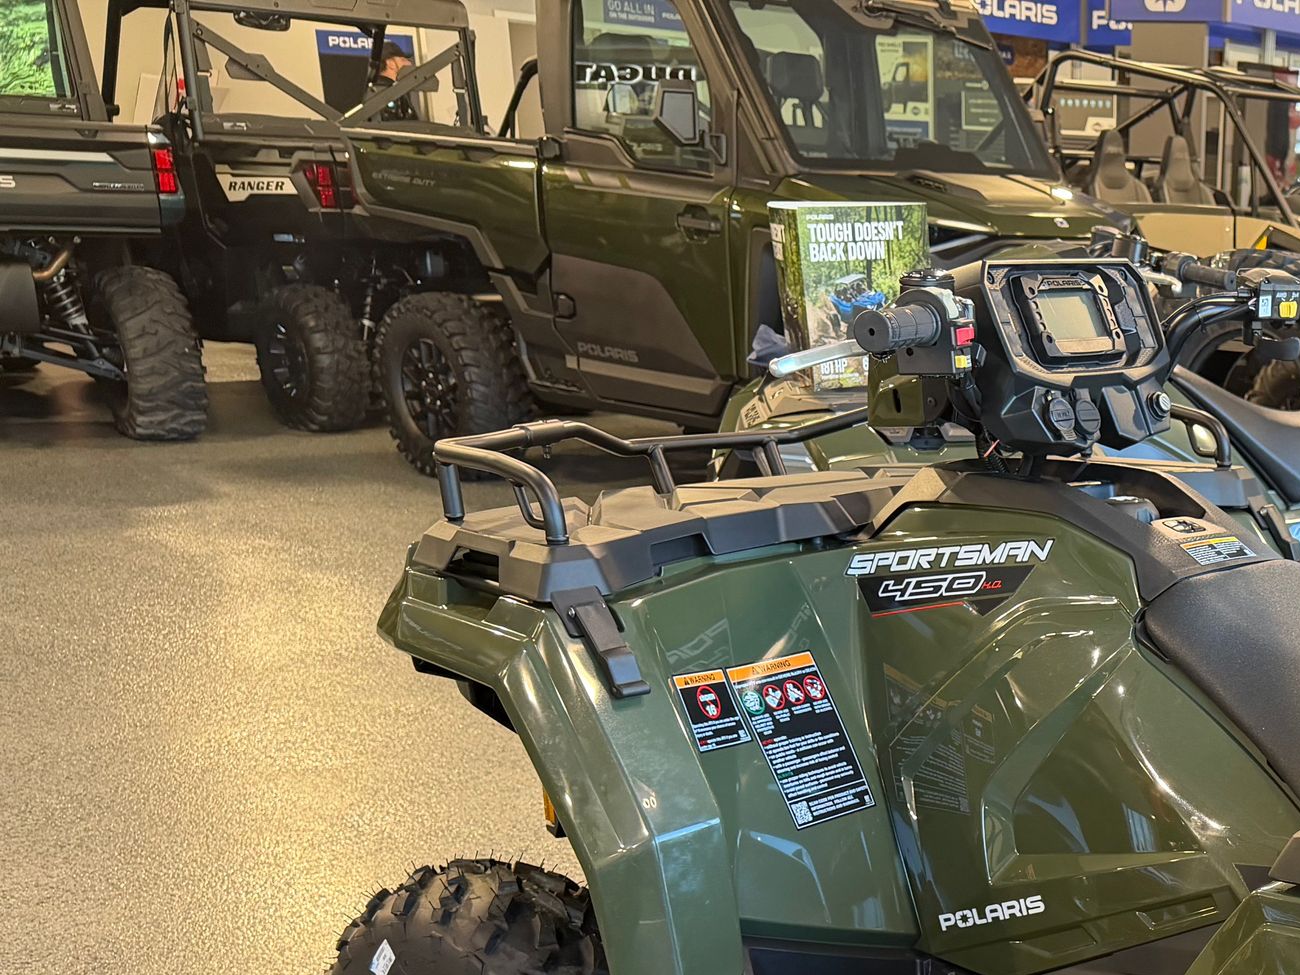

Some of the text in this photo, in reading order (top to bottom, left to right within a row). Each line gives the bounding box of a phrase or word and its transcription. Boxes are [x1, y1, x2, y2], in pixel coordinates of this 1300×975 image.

[974, 0, 1058, 25] OLARIS
[228, 181, 285, 192] RANGER
[807, 222, 853, 243] TOUGH
[854, 220, 904, 241] DOESN'T
[809, 242, 847, 263] BACK
[847, 240, 886, 261] DOWN
[577, 341, 639, 363] POLARIS
[836, 358, 848, 373] HP
[846, 539, 1054, 575] SPORTSMAN
[878, 571, 987, 602] 450
[759, 660, 791, 672] WARNING
[689, 674, 716, 684] WARNING
[938, 895, 1045, 932] POLARIS
